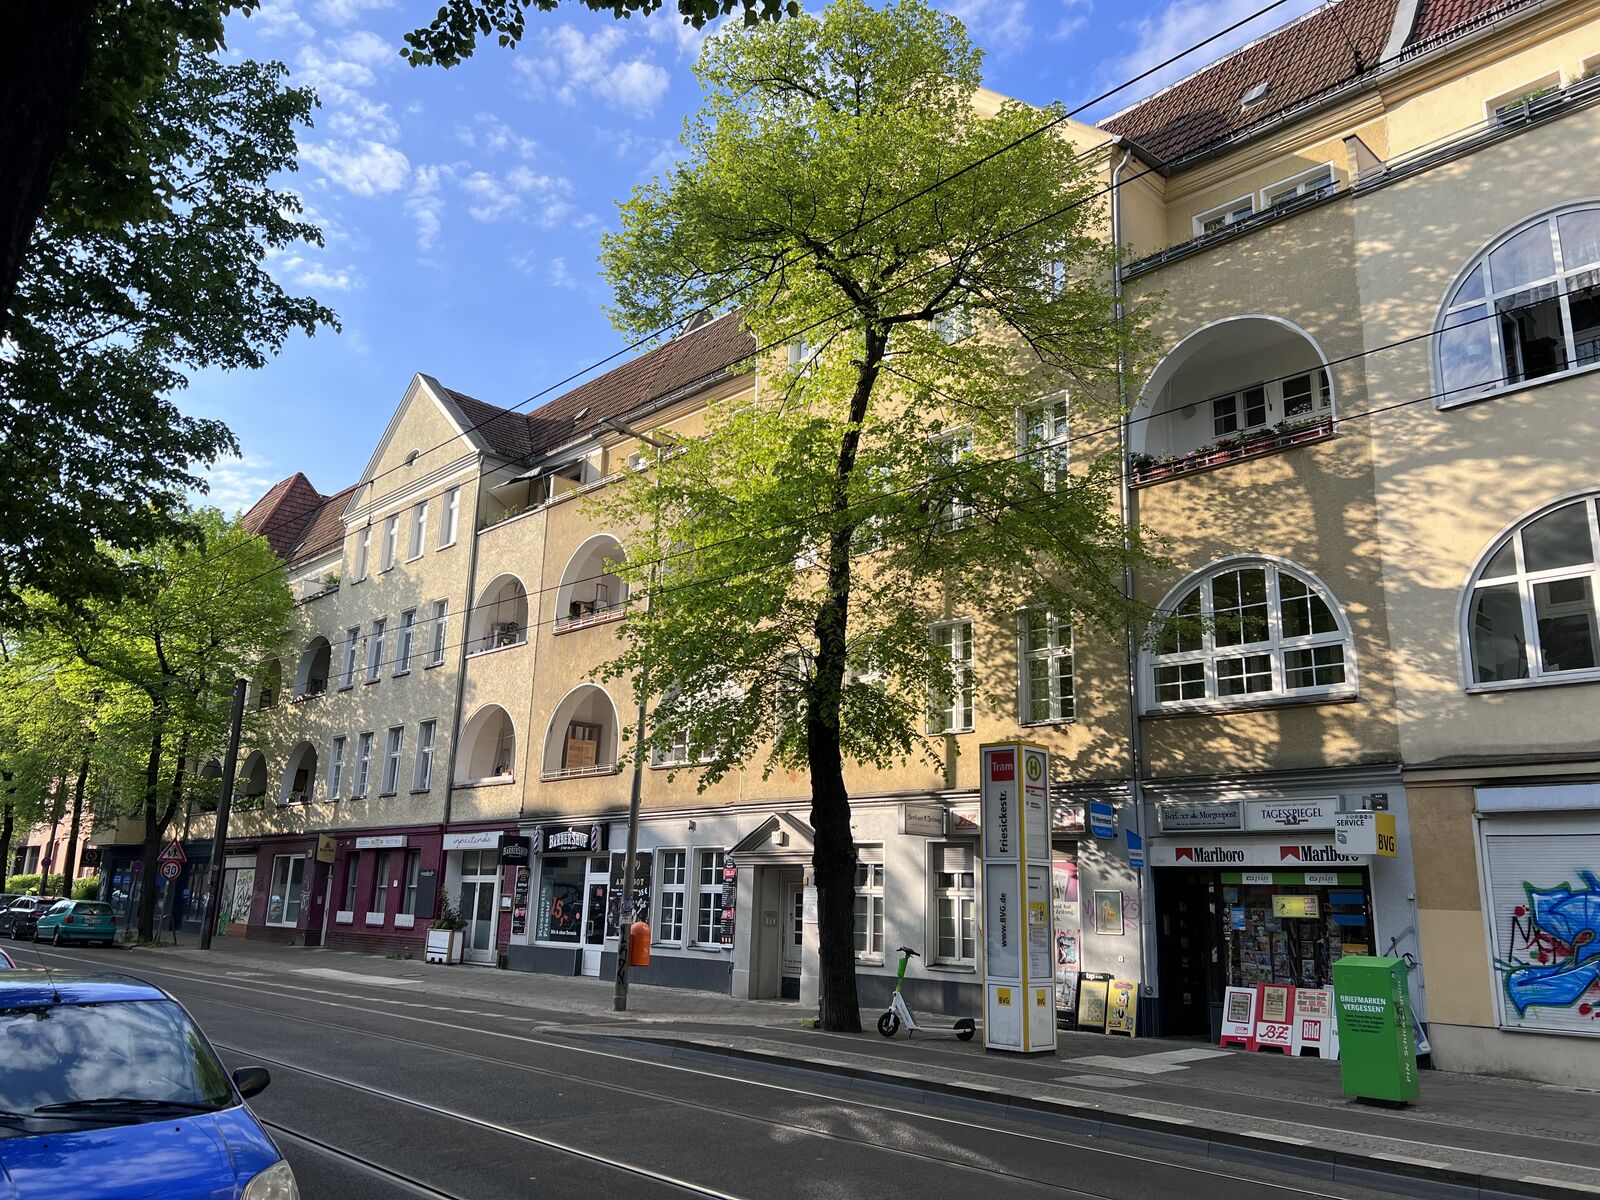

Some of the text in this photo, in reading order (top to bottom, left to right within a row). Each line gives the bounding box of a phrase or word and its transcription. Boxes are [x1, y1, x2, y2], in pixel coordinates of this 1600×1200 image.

[992, 761, 1013, 772] Tram
[1165, 810, 1237, 820] Berliner Morgenpost
[1261, 807, 1323, 819] TAGESSPIEGEL
[999, 790, 1008, 853] Friesickestr.
[1336, 819, 1365, 827] SERVICE
[548, 831, 589, 849] BARBERSHOP
[1378, 833, 1395, 852] BVG
[1193, 847, 1244, 863] Marlboro
[165, 865, 177, 875] 30
[615, 878, 645, 886] ANBOT
[538, 888, 546, 937] Kosmetik
[998, 996, 1010, 1005] BVG
[1340, 995, 1386, 1005] BRIEFMARKEN
[1343, 1004, 1384, 1013] VERGESSEN?
[1303, 1021, 1320, 1039] Bild
